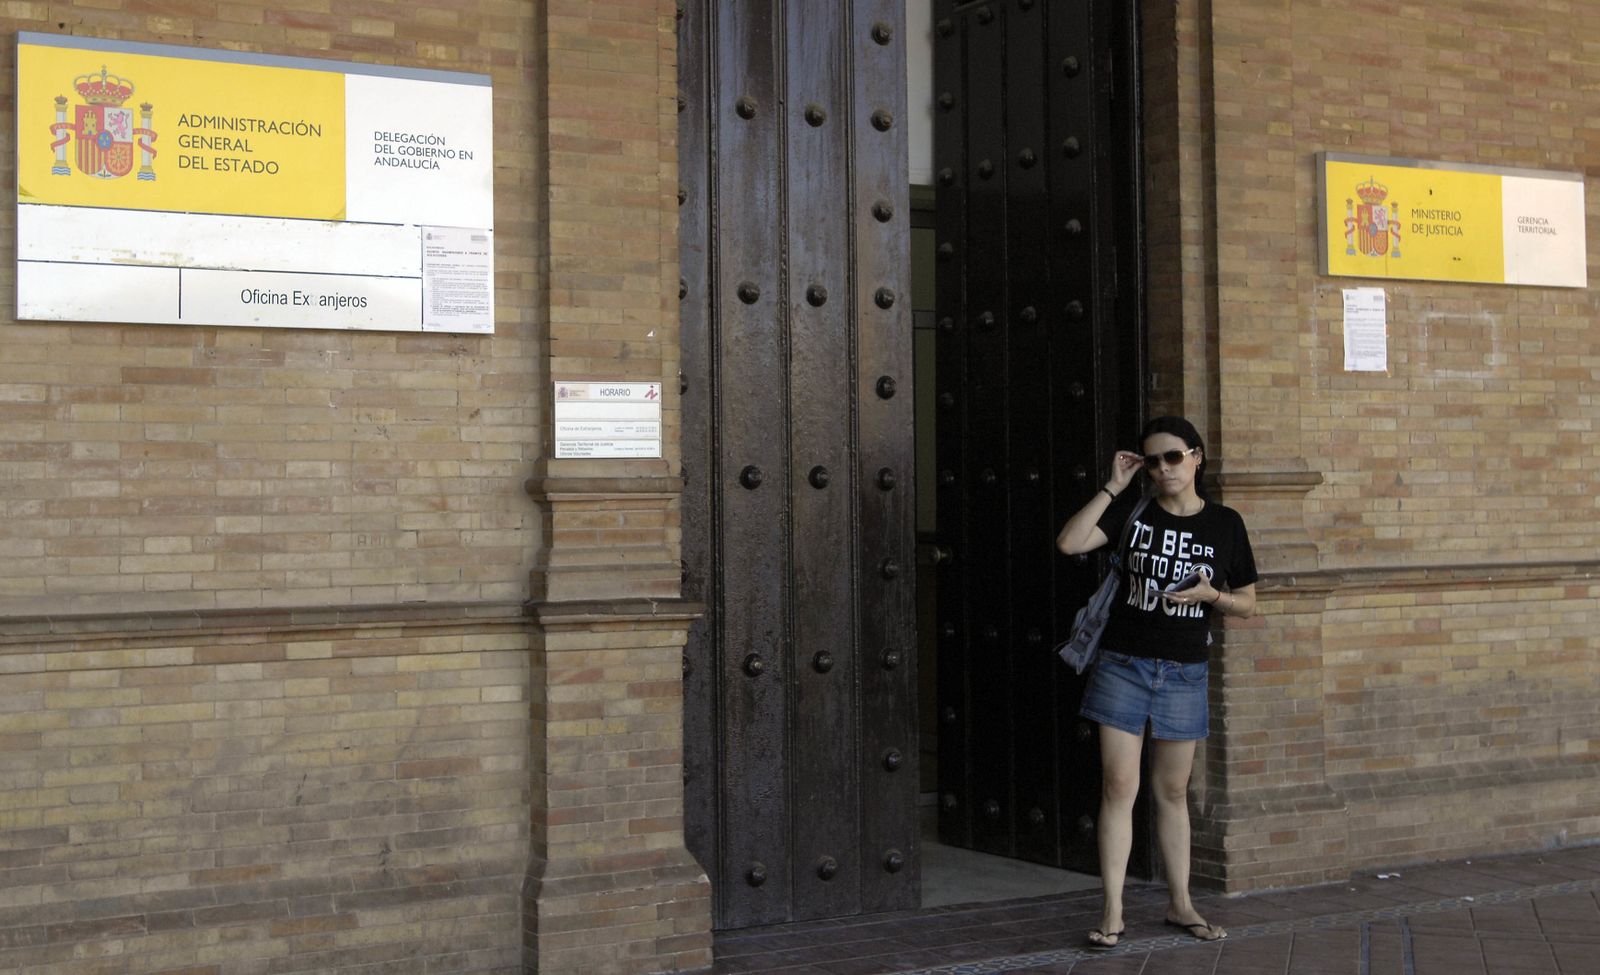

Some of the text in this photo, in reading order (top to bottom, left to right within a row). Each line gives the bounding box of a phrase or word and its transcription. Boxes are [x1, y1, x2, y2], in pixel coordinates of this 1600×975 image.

[178, 113, 321, 137] ADMINISTRACIÓN
[178, 134, 253, 152] GENERAL
[374, 131, 446, 146] DELEGACIÓN
[374, 143, 473, 161] DEL GOBIERNO EN
[178, 155, 279, 175] DEL ESTADO
[374, 156, 441, 170] ANDALUCÍA
[1411, 208, 1462, 222] MINISTERIO
[1517, 215, 1549, 225] GERENCIA
[1411, 223, 1463, 237] DE JUSTICIA
[1518, 225, 1557, 236] TERRITORIAL
[240, 288, 368, 311] Oficina Exanjeros
[599, 388, 631, 397] HORARIO
[1130, 520, 1215, 559] TO BE OR
[1151, 554, 1169, 579] TO
[1172, 560, 1193, 581] BE
